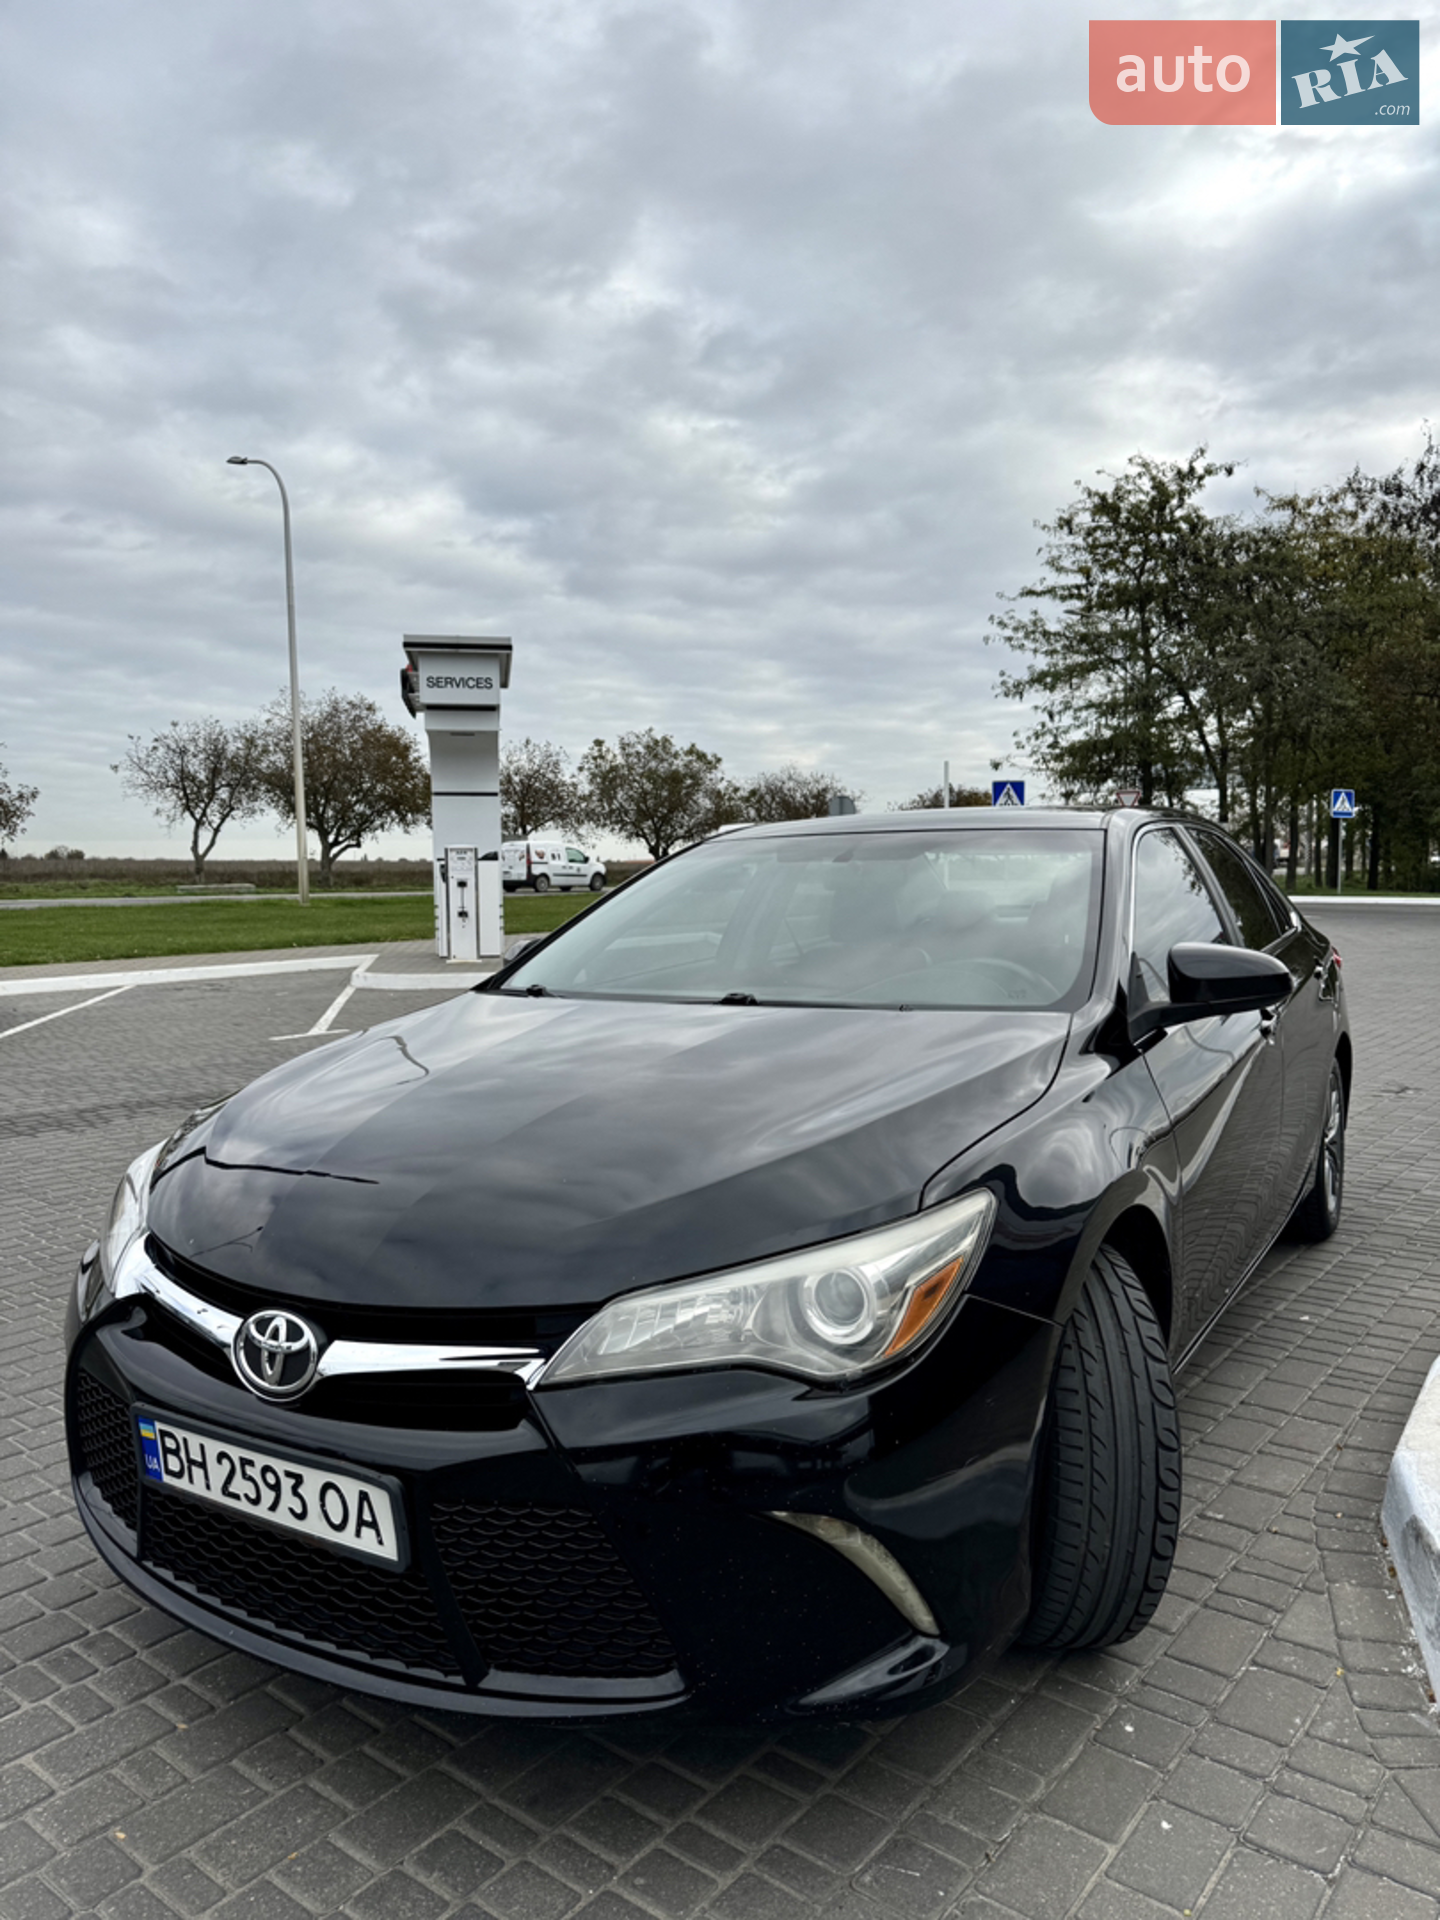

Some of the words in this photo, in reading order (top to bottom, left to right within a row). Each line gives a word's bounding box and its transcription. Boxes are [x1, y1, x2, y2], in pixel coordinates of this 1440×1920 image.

[426, 676, 493, 689] SERVICES
[145, 1454, 161, 1472] UA
[158, 1428, 211, 1491] BH
[216, 1450, 309, 1521] 2593
[319, 1480, 385, 1546] OA
